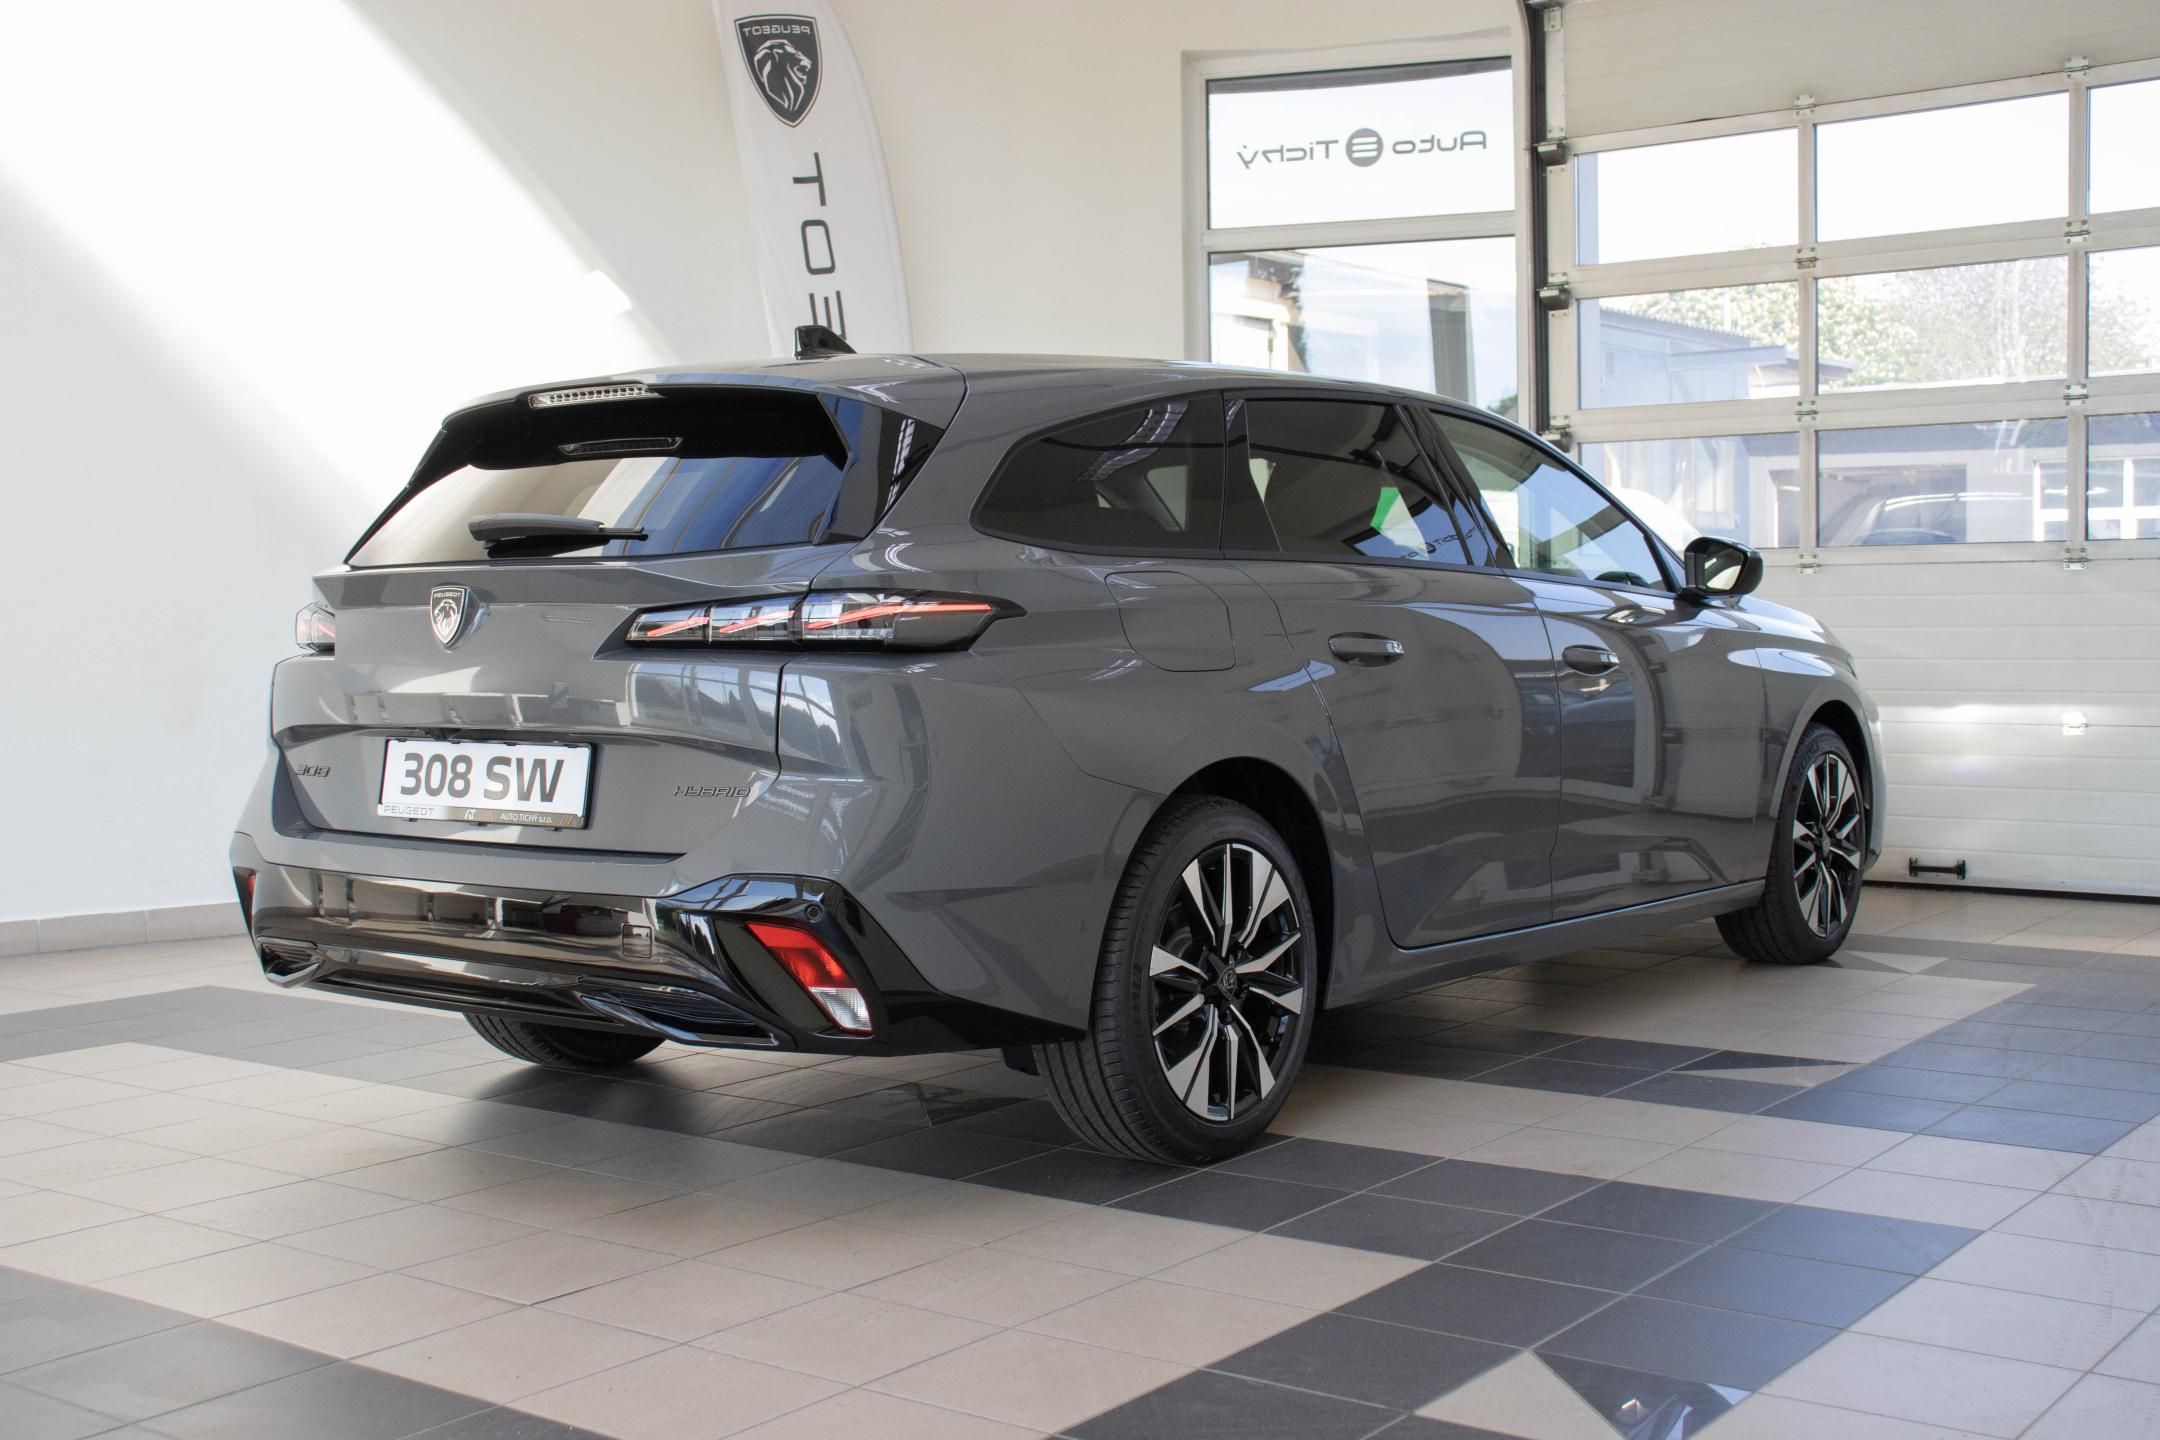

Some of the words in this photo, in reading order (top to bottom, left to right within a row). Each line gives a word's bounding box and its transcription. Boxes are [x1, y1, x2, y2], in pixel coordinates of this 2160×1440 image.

[296, 764, 331, 777] 308
[400, 752, 473, 798] 308
[483, 755, 565, 802] SW
[674, 785, 751, 797] HYBRID
[384, 804, 434, 816] PEUGEOT
[501, 812, 518, 821] AUTO
